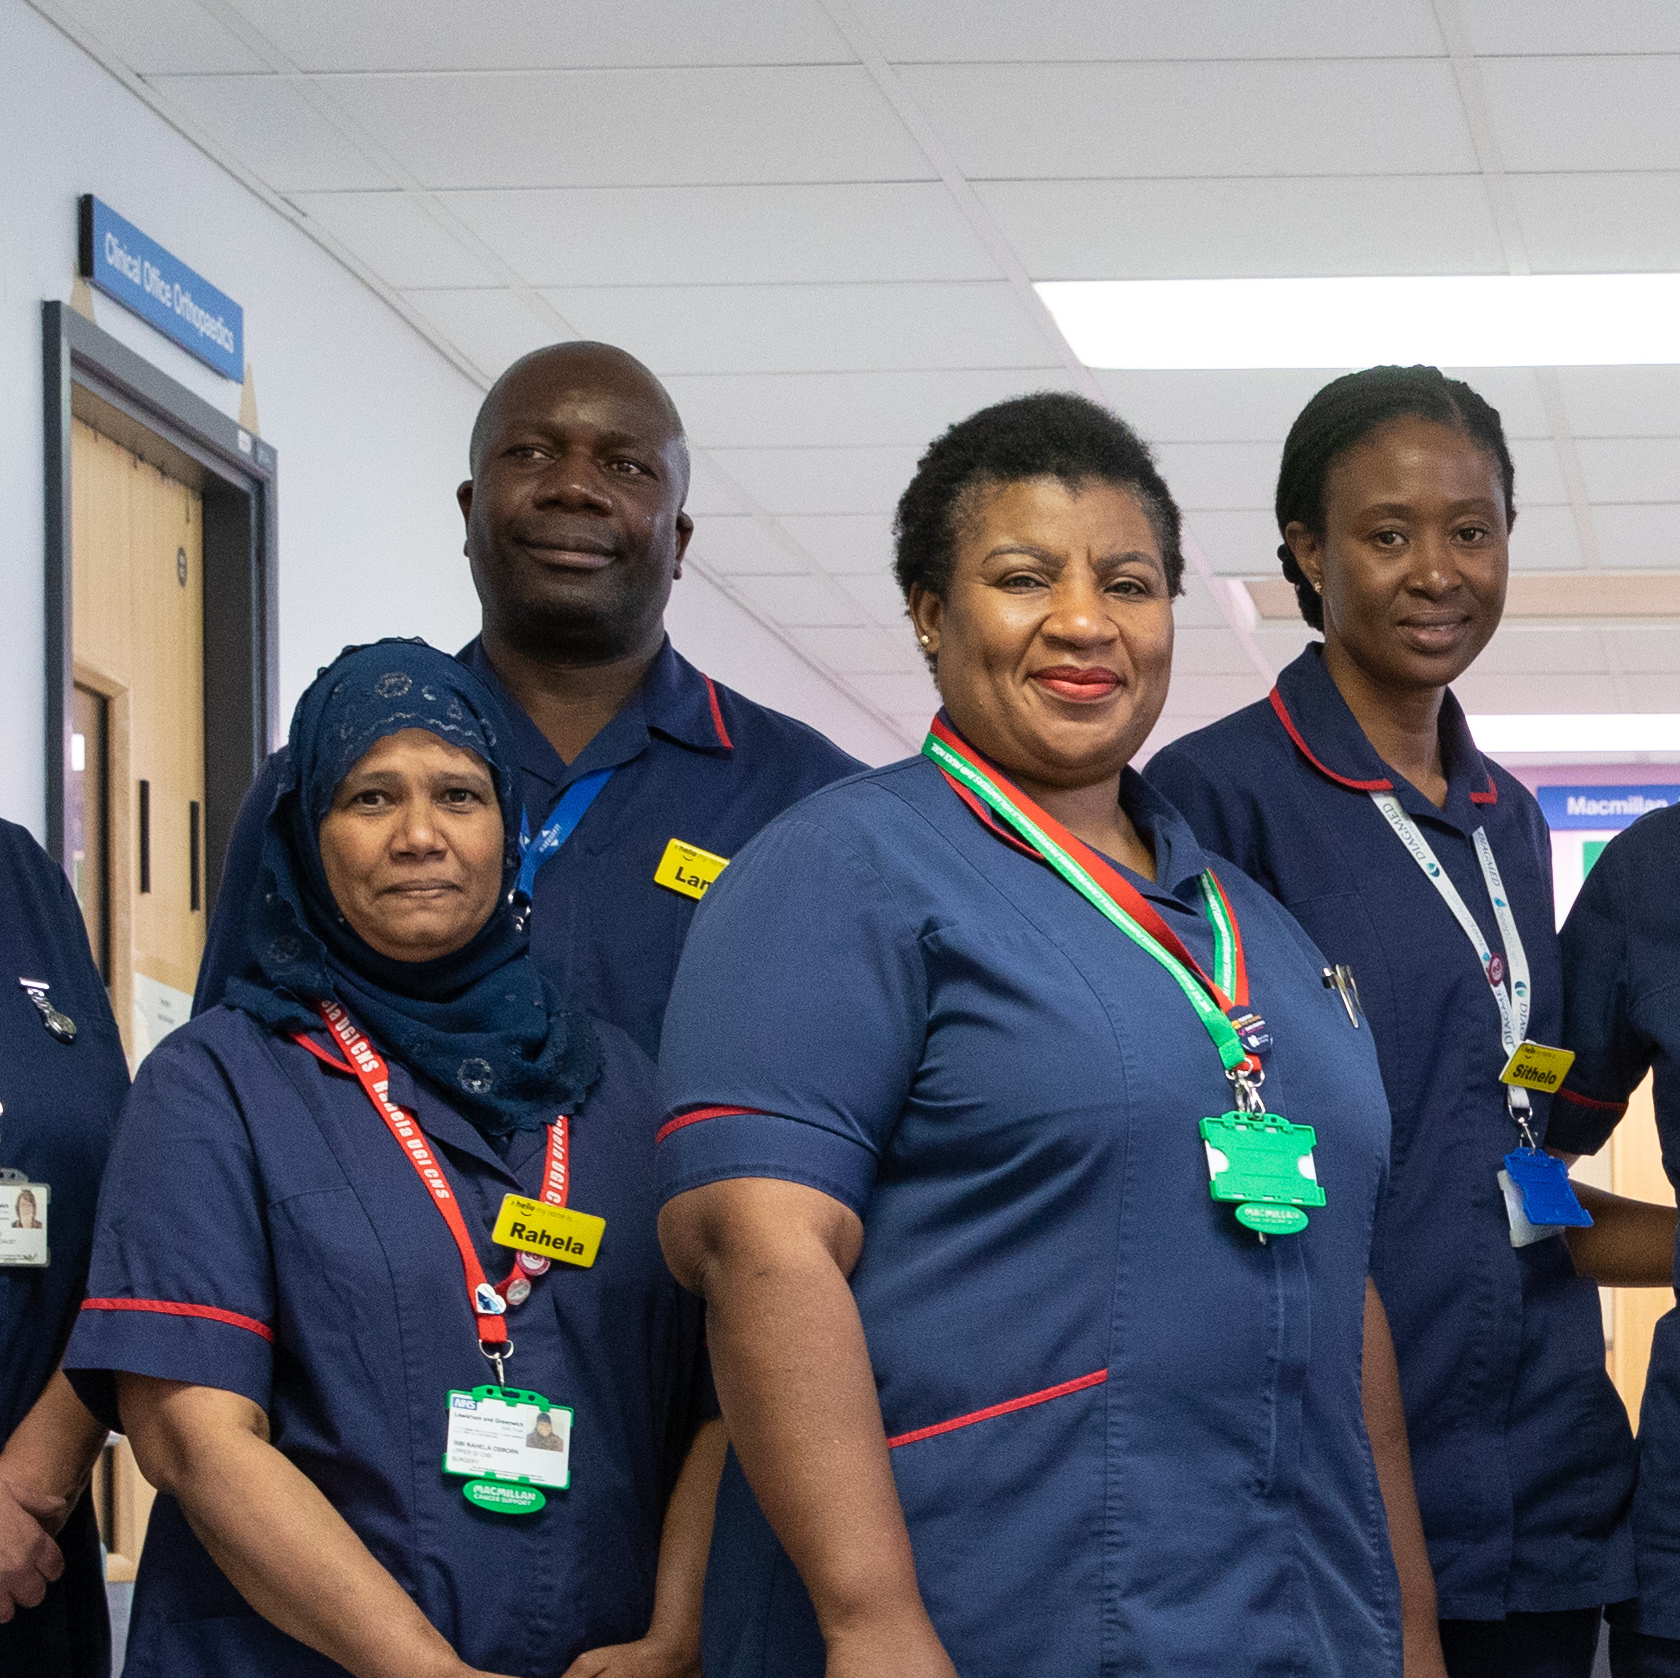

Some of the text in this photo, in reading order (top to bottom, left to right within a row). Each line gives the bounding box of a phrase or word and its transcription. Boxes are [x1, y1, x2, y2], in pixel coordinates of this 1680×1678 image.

[105, 232, 141, 286] Clinical
[143, 261, 172, 308] Office
[1567, 795, 1668, 815] Macmillan
[1383, 803, 1426, 860] DIAGMED
[1477, 831, 1501, 887] DIAGMED
[350, 1041, 380, 1073] CNS
[1513, 1063, 1557, 1085] Sithelo
[406, 1138, 432, 1166] UGI
[423, 1168, 450, 1200] CNS
[516, 1201, 535, 1211] hello
[1244, 1208, 1300, 1219] MACMILLAN
[510, 1222, 585, 1255] Rahela
[455, 1399, 476, 1409] NHS
[473, 1485, 536, 1500] MACMILLAN
